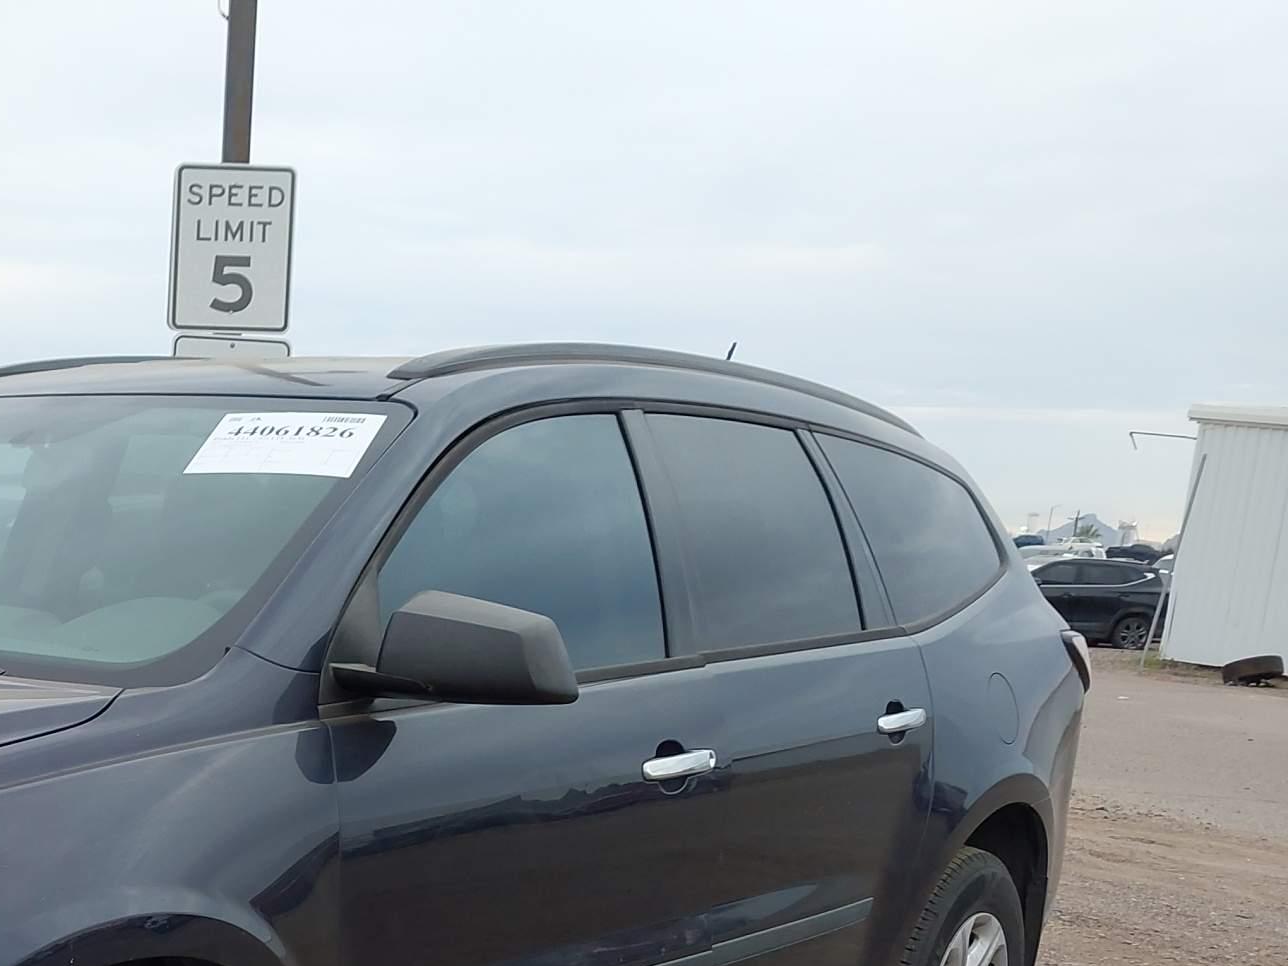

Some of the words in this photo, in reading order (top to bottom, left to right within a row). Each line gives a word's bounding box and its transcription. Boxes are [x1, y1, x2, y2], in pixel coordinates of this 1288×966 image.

[187, 183, 285, 208] SPEED
[196, 219, 273, 243] LIMIT
[209, 254, 254, 314] 5
[228, 425, 356, 439] 44061826
